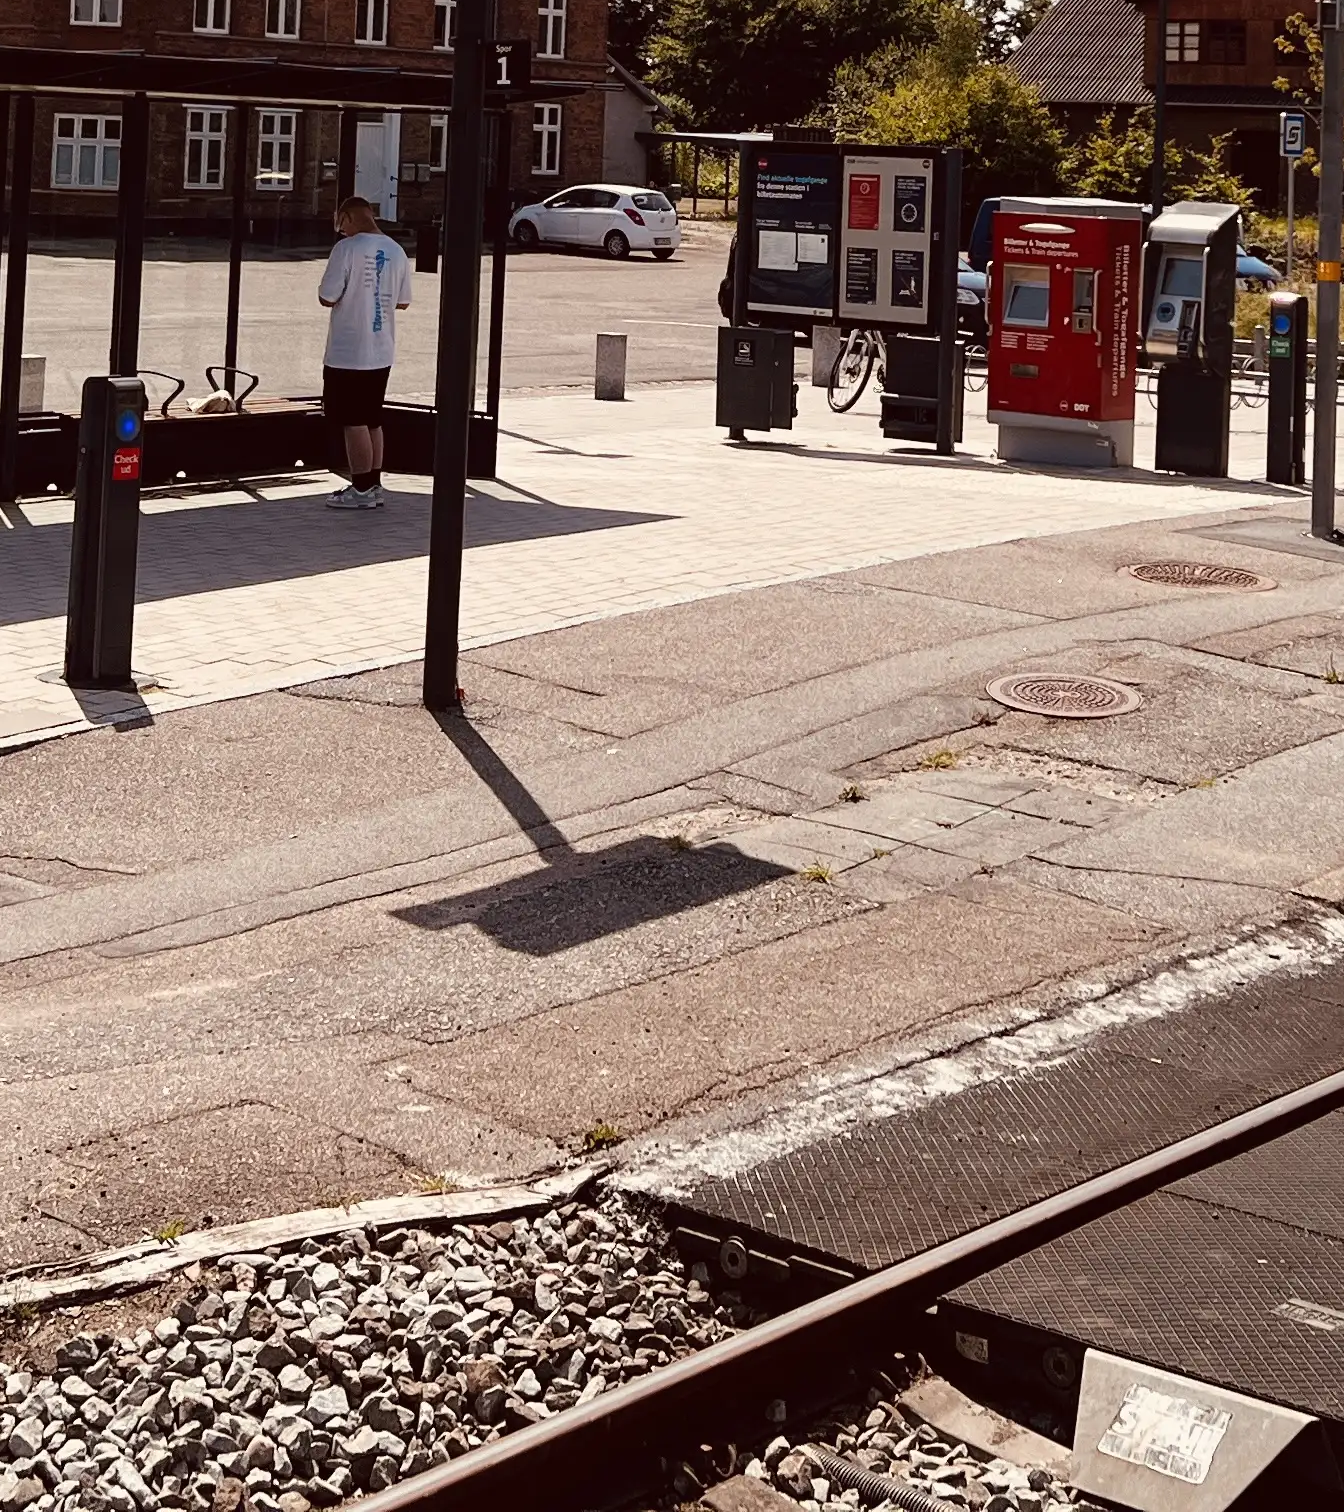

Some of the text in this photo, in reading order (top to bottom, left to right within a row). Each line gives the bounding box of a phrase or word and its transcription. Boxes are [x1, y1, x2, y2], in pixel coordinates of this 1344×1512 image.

[495, 44, 513, 53] Spor
[496, 56, 511, 85] 1
[1004, 238, 1028, 246] Billetter
[1004, 246, 1024, 254] Tickets
[1031, 248, 1046, 256] Train
[1046, 250, 1079, 258] departures
[1122, 245, 1130, 293] Billetter
[1121, 296, 1129, 306] &
[1112, 246, 1123, 397] Tickets & Train departures
[114, 454, 138, 464] Check
[121, 464, 131, 473] ud
